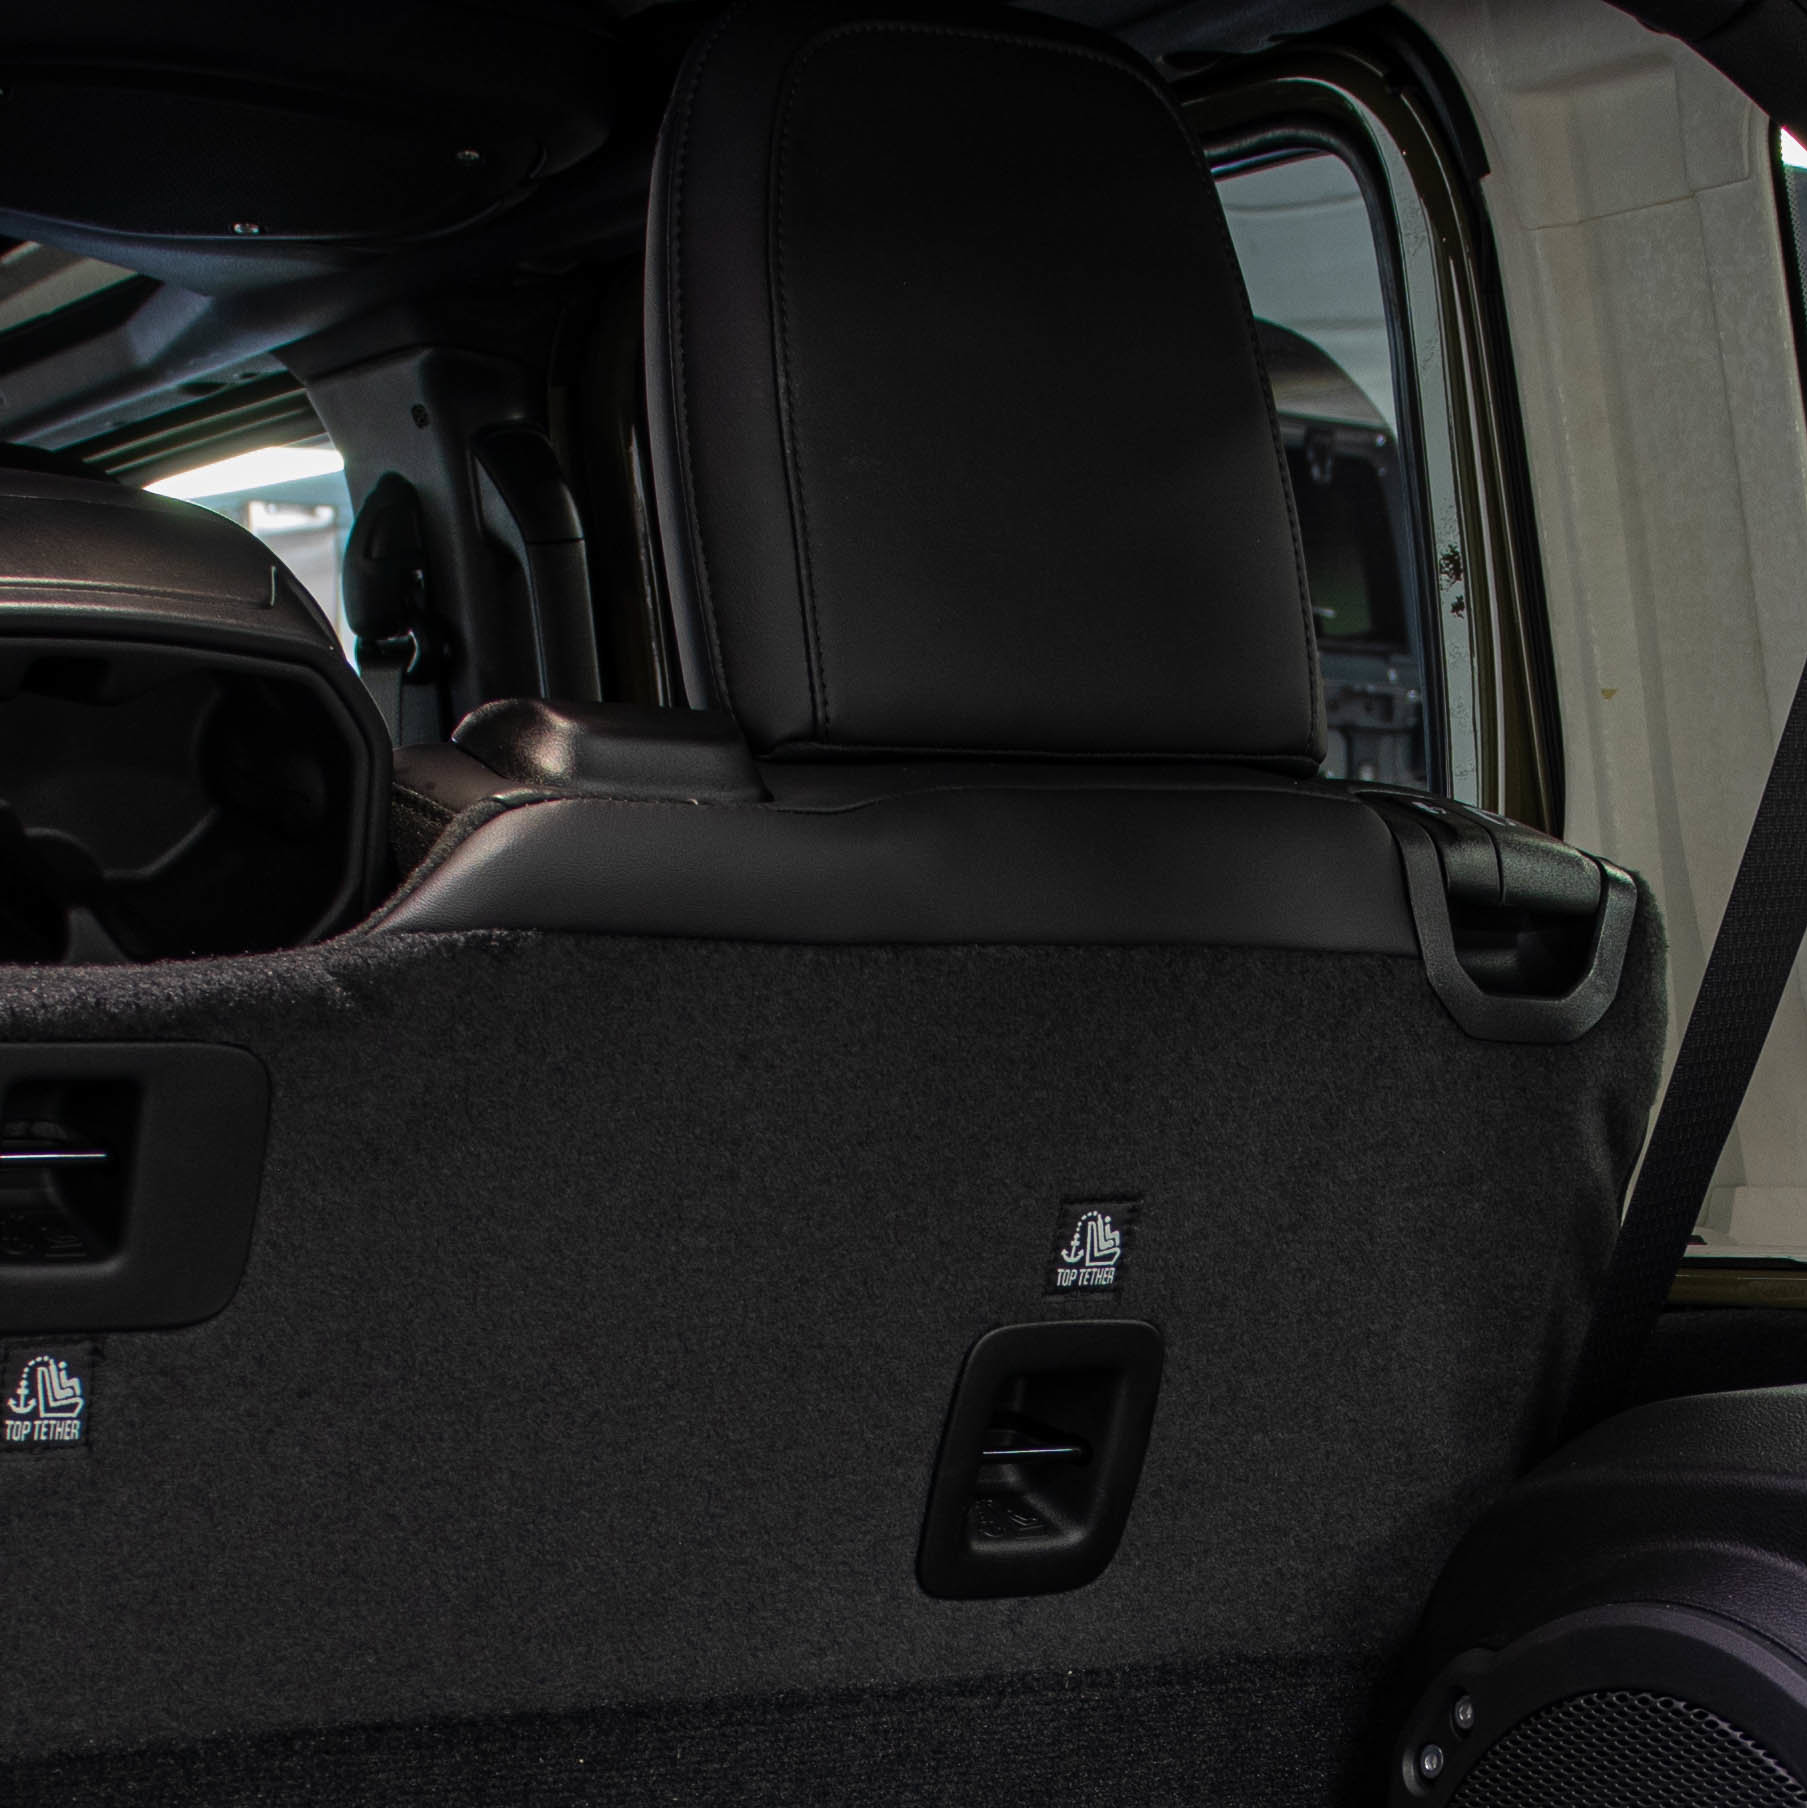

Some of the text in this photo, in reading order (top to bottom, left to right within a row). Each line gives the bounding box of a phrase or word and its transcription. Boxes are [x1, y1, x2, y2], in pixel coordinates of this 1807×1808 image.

[1056, 1267, 1117, 1287] TOP TETHER
[3, 1419, 82, 1441] TOP TETHER
